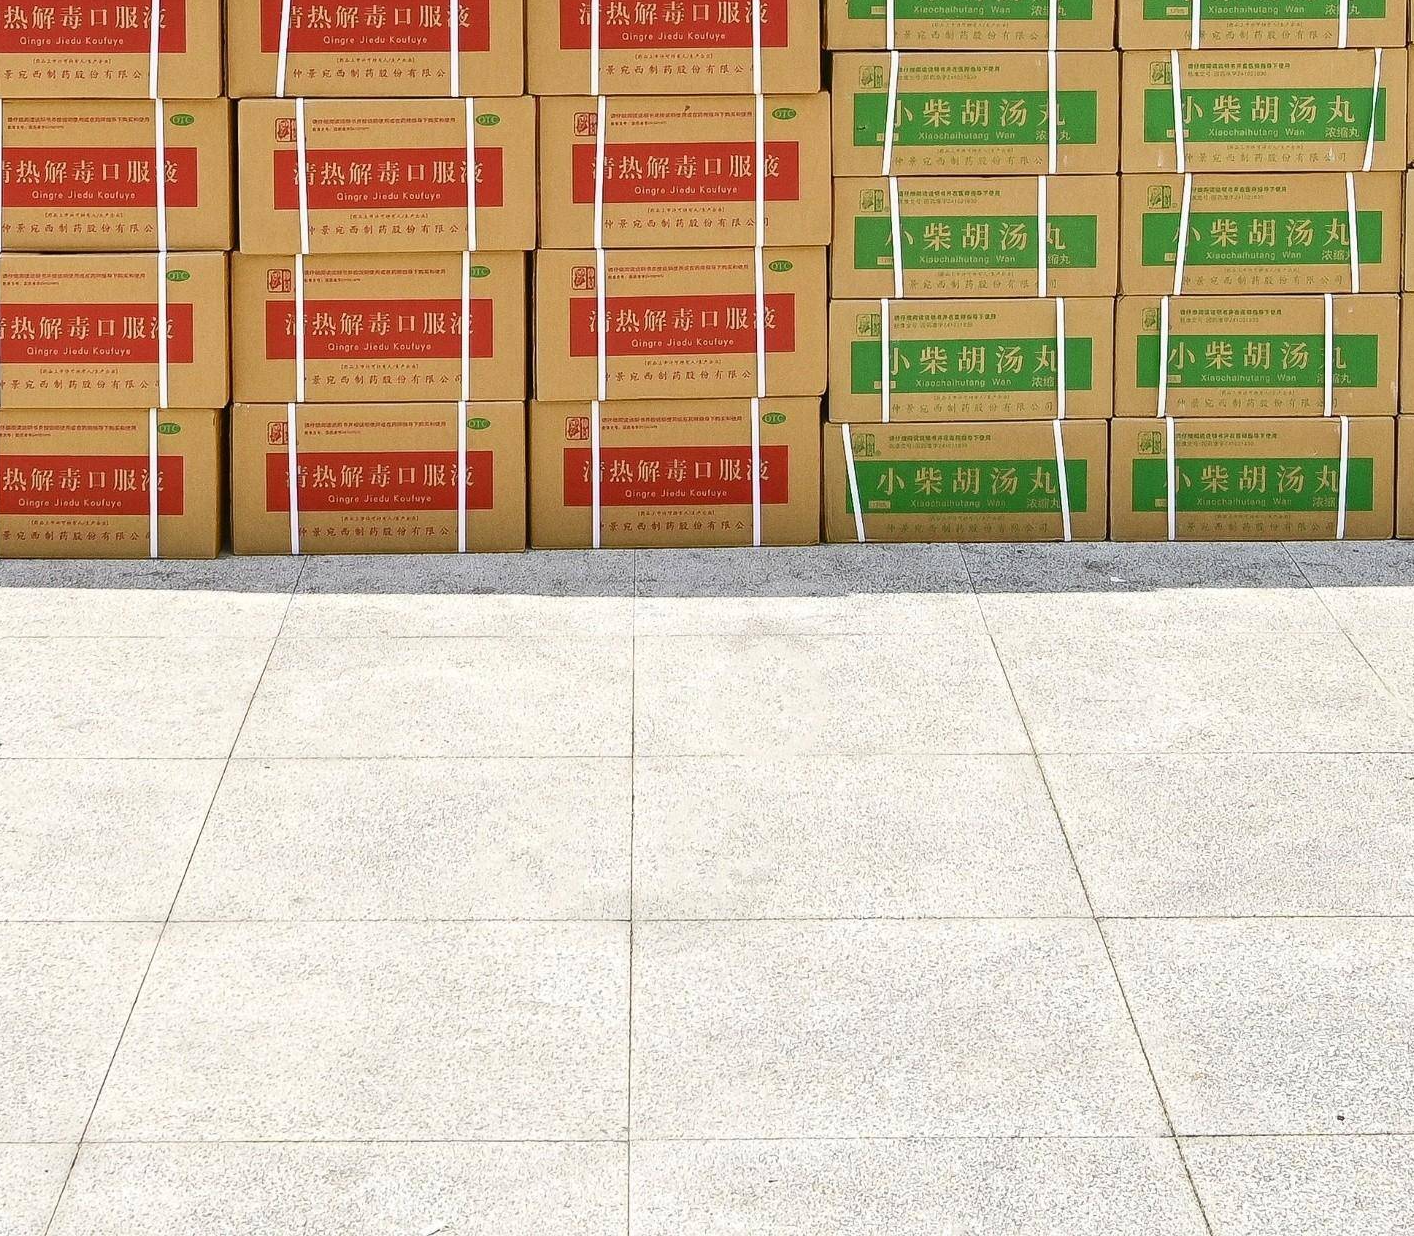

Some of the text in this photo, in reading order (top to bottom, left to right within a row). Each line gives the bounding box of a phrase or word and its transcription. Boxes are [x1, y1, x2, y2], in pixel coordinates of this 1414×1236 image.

[323, 36, 354, 45] Qingre
[390, 36, 427, 45] Koufuye
[293, 67, 448, 79] 仲景宛西制药股份有限公
[1185, 95, 1356, 124] 小柴胡汤丸
[1209, 129, 1279, 138] Xiaochaihutang
[1285, 128, 1304, 136] Wan
[337, 192, 368, 202] Qingre
[403, 192, 440, 201] Koufuye
[1, 221, 156, 233] 仲景宛西制药股份有限公
[27, 347, 131, 356] Qingre Jiedu Koufuye
[892, 345, 1055, 375] 小柴胡汤丸
[877, 467, 1056, 495] 小柴胡汤丸
[1164, 465, 1337, 493] 小柴胡汤丸
[626, 489, 727, 499] Qingre Jiedu Koufuye
[911, 500, 1005, 509] Xiaochaihutang Wan
